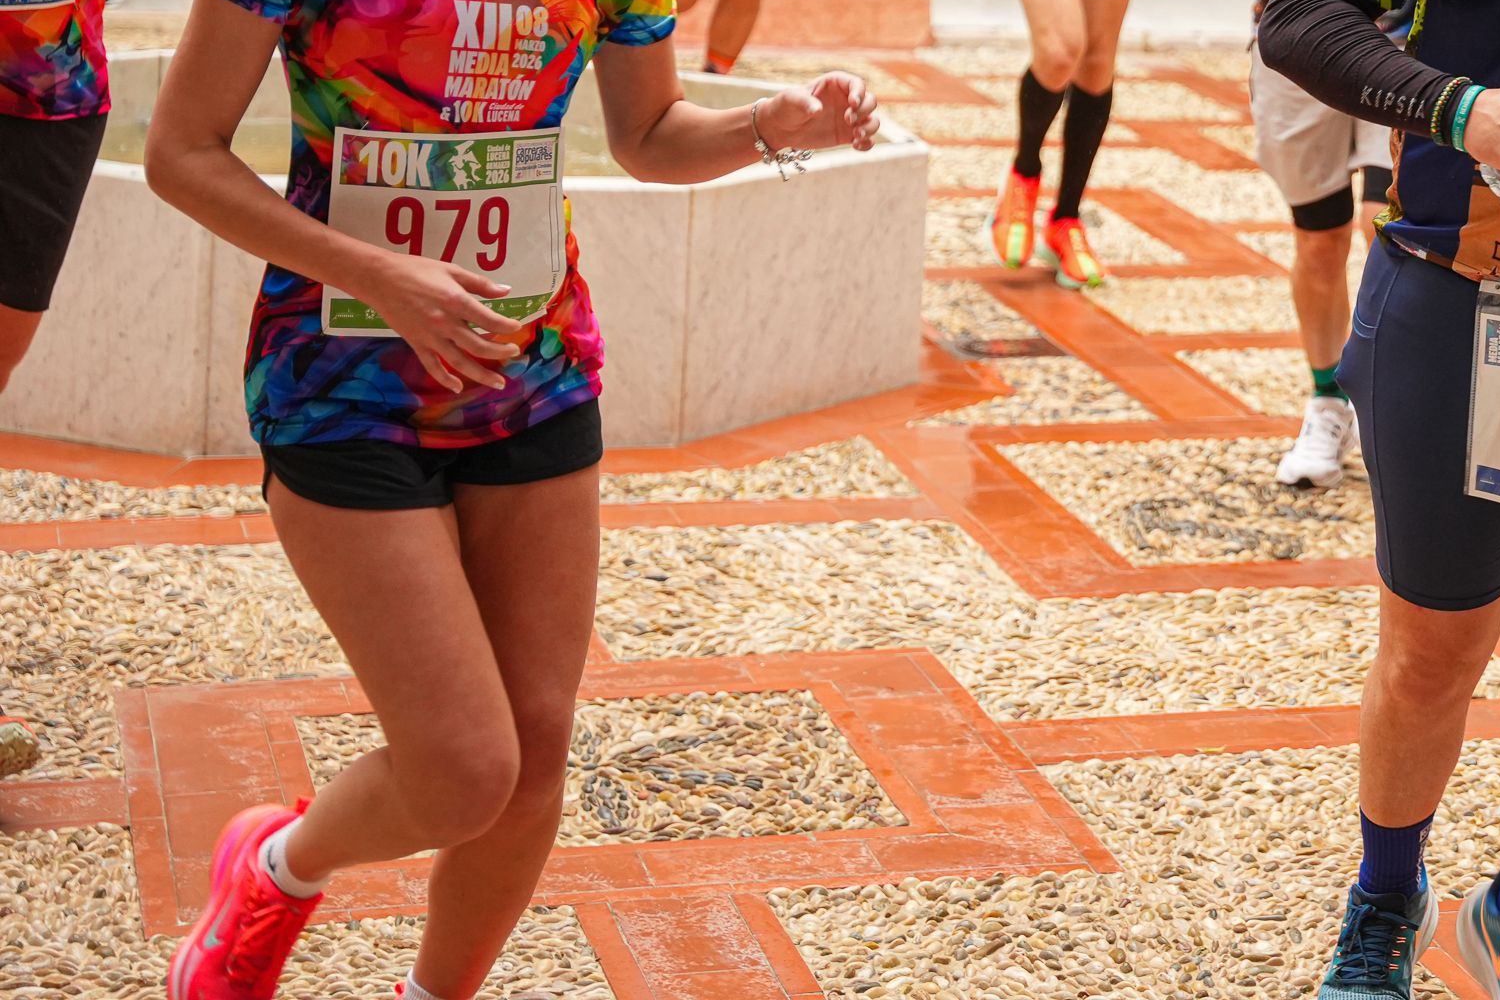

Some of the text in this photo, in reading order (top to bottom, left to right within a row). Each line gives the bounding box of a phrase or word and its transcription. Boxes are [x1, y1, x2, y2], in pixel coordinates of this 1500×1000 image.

[452, 0, 512, 51] XII
[516, 5, 549, 37] 08
[515, 39, 546, 52] MARZO
[448, 50, 510, 76] MEDIA
[512, 53, 543, 70] 2026
[444, 74, 536, 101] MARATÓN
[440, 100, 488, 123] & 10K
[488, 102, 514, 110] Ciudad
[1360, 85, 1425, 119] KIPSTA
[487, 110, 521, 122] LUCENA
[515, 152, 553, 164] populares
[516, 146, 547, 155] carreras
[359, 140, 433, 187] 10K
[485, 169, 510, 184] 2026
[385, 196, 510, 271] 979
[1487, 337, 1498, 363] MEDIA
